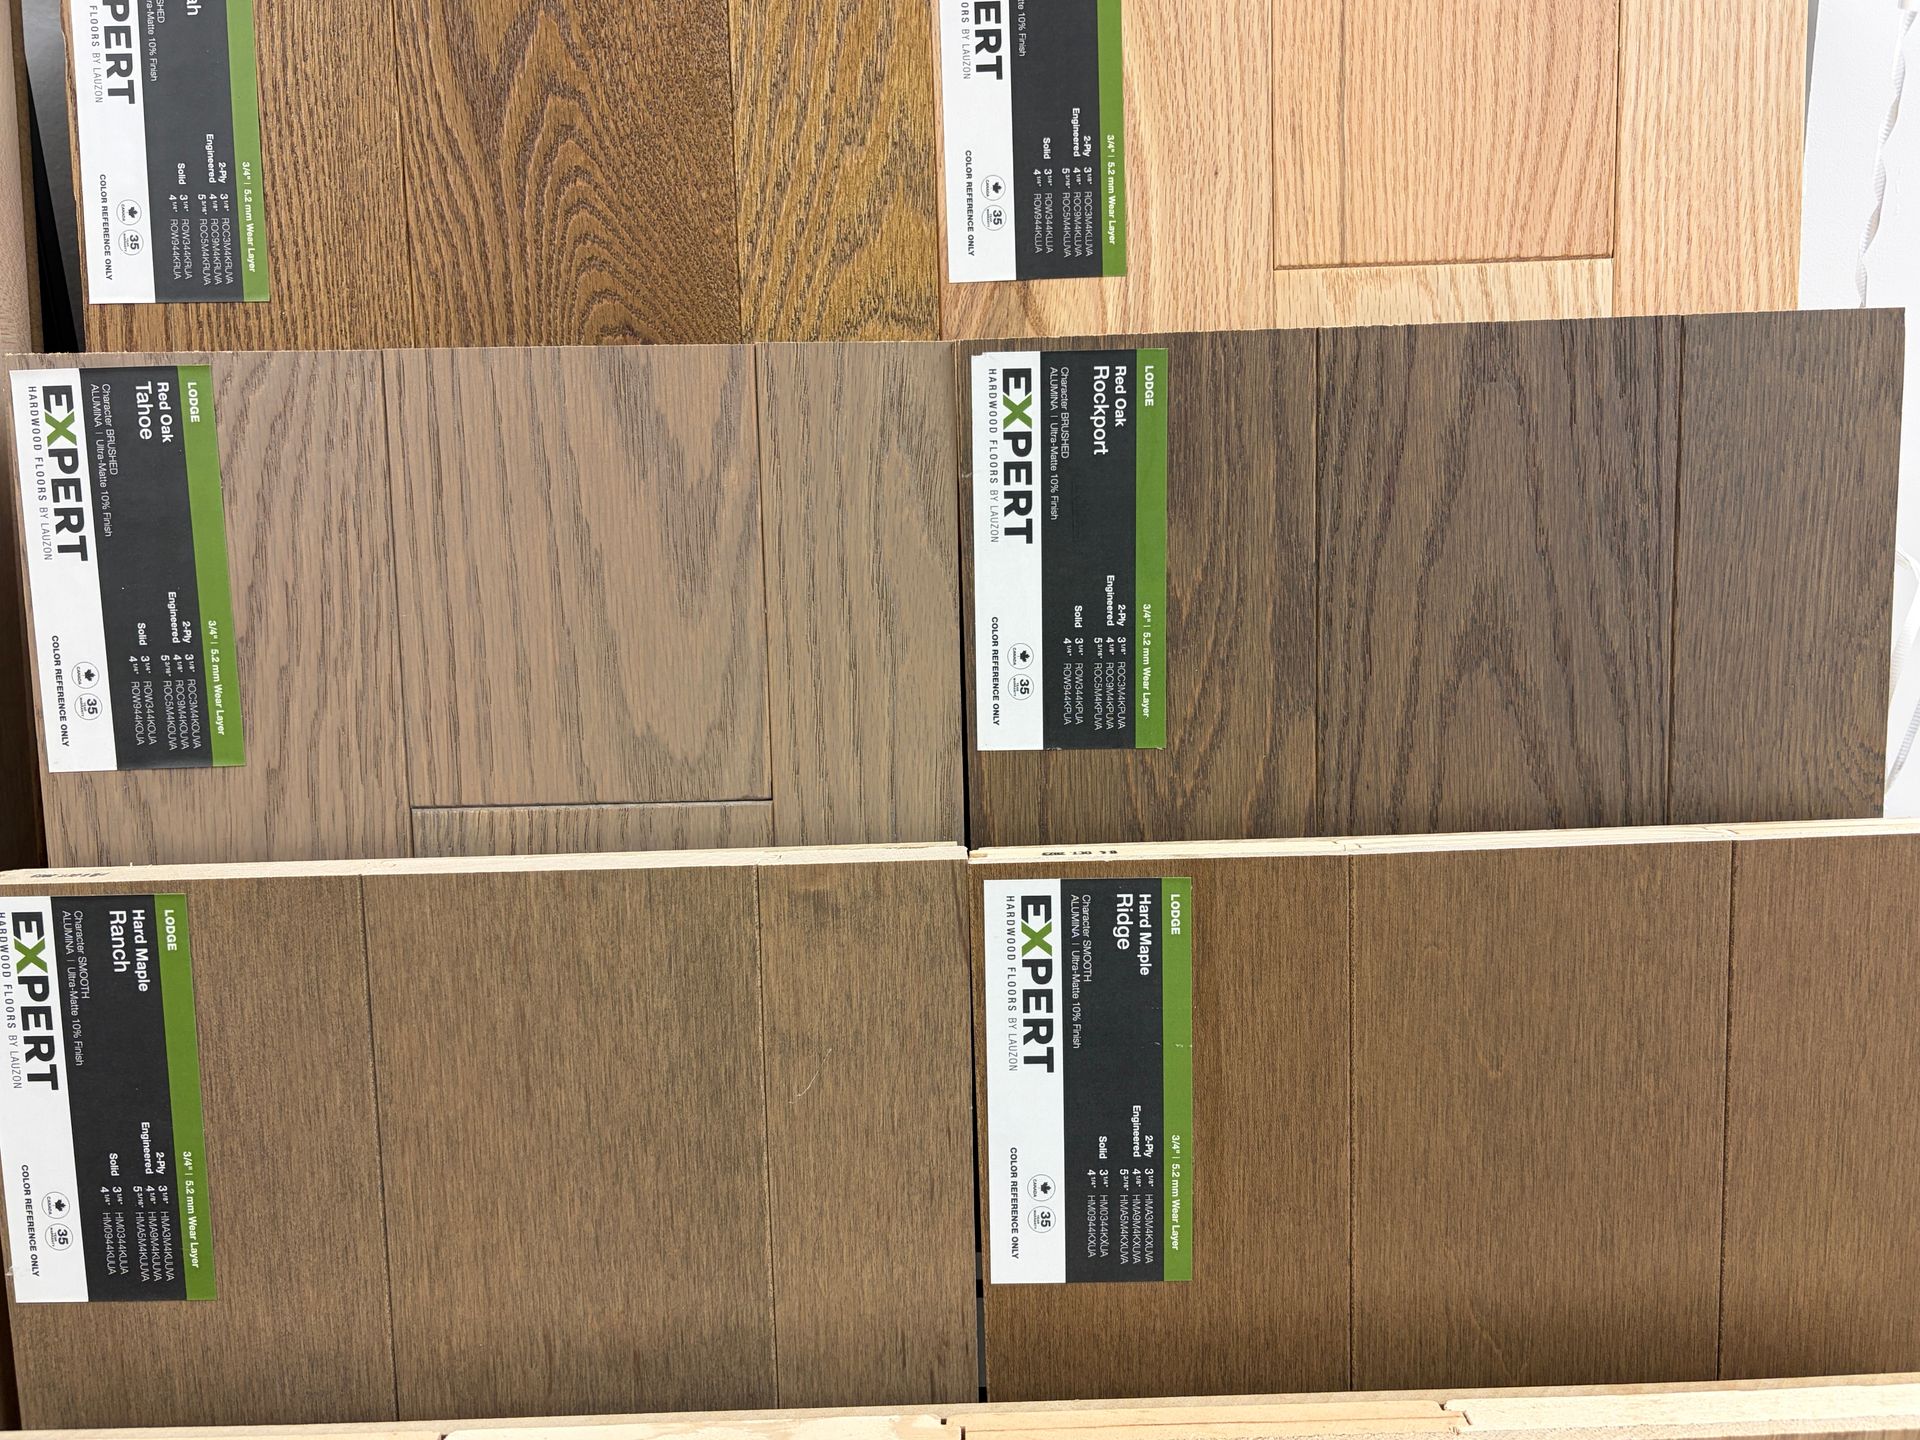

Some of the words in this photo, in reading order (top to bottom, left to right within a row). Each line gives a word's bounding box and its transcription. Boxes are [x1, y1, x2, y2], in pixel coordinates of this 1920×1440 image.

[89, 5, 100, 47] FLOORS
[961, 28, 970, 41] BY
[1017, 12, 1026, 31] 10%
[91, 52, 101, 64] BY
[148, 37, 157, 56] 10%
[1018, 32, 1027, 57] Finish
[149, 58, 158, 82] Finish
[961, 43, 972, 80] LAUZON
[92, 67, 104, 103] LAUZON
[1070, 107, 1081, 157] Engineered
[1106, 134, 1115, 153] 3/4"
[205, 133, 217, 183] Engineered
[1042, 137, 1051, 160] Solid
[1082, 135, 1092, 157] 2-Ply
[177, 162, 187, 185] Solid
[217, 162, 228, 184] 2-Ply
[241, 161, 251, 180] 3/4"
[965, 149, 973, 180] COLOR
[1107, 161, 1116, 176] 5.2
[99, 174, 108, 204] COLOR
[243, 188, 253, 203] 5.2
[1107, 176, 1115, 194] mm
[244, 204, 252, 222] mm
[966, 181, 975, 233] REFERENCE
[992, 209, 1003, 226] 35
[1108, 195, 1116, 219] Wear
[101, 205, 112, 257] REFERENCE
[129, 234, 140, 250] 35
[246, 223, 255, 247] Wear
[1107, 220, 1117, 245] Layer
[967, 234, 975, 257] ONLY
[104, 258, 113, 281] ONLY
[246, 247, 256, 273] Layer
[1049, 366, 1059, 411] ALUMINA
[1060, 366, 1070, 411] Character
[1115, 365, 1127, 394] Red
[1144, 365, 1155, 407] LODGE
[90, 383, 103, 428] ALUMINA
[101, 383, 113, 427] Character
[157, 382, 172, 410] Red
[187, 382, 200, 423] LODGE
[988, 368, 998, 434] HARDWOOD
[27, 386, 43, 451] HARDWOOD
[135, 380, 154, 440] Tahoe
[1089, 365, 1110, 456] Rockport
[1114, 397, 1127, 427] Oak
[160, 414, 174, 443] Oak
[1060, 412, 1070, 459] BRUSHED
[105, 429, 119, 475] BRUSHED
[1002, 367, 1033, 545] EXPERT
[1049, 422, 1059, 472] Ultra-Matte
[41, 384, 89, 562] EXPERT
[95, 439, 108, 488] Ultra-Matte
[989, 439, 999, 484] FLOORS
[34, 456, 48, 501] FLOORS
[1050, 474, 1059, 494] 10%
[100, 490, 111, 510] 10%
[989, 489, 999, 502] BY
[1050, 495, 1059, 521] Finish
[39, 506, 49, 519] BY
[102, 512, 113, 537] Finish
[989, 505, 1000, 543] LAUZON
[40, 522, 53, 561] LAUZON
[1104, 574, 1115, 626] Engineered
[1142, 603, 1152, 623] 3/4"
[167, 591, 181, 644] Engineered
[1074, 605, 1083, 628] Solid
[1116, 604, 1126, 627] 2-Ply
[137, 622, 148, 646] Solid
[182, 620, 192, 644] 2-Ply
[208, 620, 218, 639] 3/4"
[991, 616, 999, 647] COLOR
[1142, 632, 1151, 646] 5.2
[51, 635, 62, 666] COLOR
[210, 648, 220, 663] 5.2
[1142, 647, 1150, 665] mm
[212, 664, 220, 682] mm
[991, 649, 1000, 701] REFERENCE
[1019, 678, 1030, 695] 35
[1142, 666, 1152, 691] Wear
[54, 668, 67, 722] REFERENCE
[86, 698, 99, 715] 35
[213, 684, 223, 708] Wear
[1141, 692, 1151, 718] Layer
[215, 709, 225, 736] Layer
[992, 703, 1000, 726] ONLY
[60, 723, 70, 747] ONLY
[1070, 894, 1081, 939] ALUMINA
[1081, 894, 1092, 938] Character
[1113, 893, 1134, 950] Ridge
[1139, 894, 1152, 928] Hard
[1170, 893, 1181, 935] LODGE
[62, 910, 75, 955] ALUMINA
[73, 910, 85, 955] Character
[132, 909, 148, 944] Hard
[164, 909, 178, 951] LODGE
[1005, 895, 1017, 961] HARDWOOD
[109, 910, 131, 973] Ranch
[1138, 932, 1152, 976] Maple
[135, 948, 151, 992] Maple
[1082, 939, 1093, 982] SMOOTH
[77, 956, 91, 999] SMOOTH
[1020, 894, 1055, 1074] EXPERT
[1071, 950, 1081, 999] Ultra-Matte
[11, 911, 59, 1091] EXPERT
[67, 966, 79, 1016] Ultra-Matte
[1007, 966, 1017, 1012] FLOORS
[3, 984, 17, 1029] FLOORS
[1072, 1001, 1082, 1022] 10%
[72, 1018, 82, 1039] 10%
[1007, 1017, 1018, 1030] BY
[1072, 1023, 1082, 1049] Finish
[8, 1034, 19, 1047] BY
[73, 1040, 84, 1066] Finish
[1008, 1033, 1019, 1071] LAUZON
[9, 1050, 23, 1089] LAUZON
[1130, 1105, 1142, 1158] Engineered
[1171, 1134, 1181, 1154] 3/4"
[140, 1121, 154, 1175] Engineered
[1098, 1135, 1108, 1159] Solid
[1143, 1135, 1154, 1158] 2-Ply
[109, 1152, 120, 1177] Solid
[155, 1151, 166, 1175] 2-Ply
[182, 1151, 193, 1171] 3/4"
[1009, 1147, 1018, 1178] COLOR
[1171, 1163, 1181, 1178] 5.2
[21, 1164, 32, 1196] COLOR
[185, 1180, 195, 1195] 5.2
[1171, 1179, 1179, 1197] mm
[186, 1196, 195, 1214] mm
[1010, 1180, 1019, 1234] REFERENCE
[1171, 1199, 1181, 1223] Wear
[24, 1198, 38, 1252] REFERENCE
[188, 1215, 198, 1241] Wear
[1040, 1211, 1052, 1228] 35
[57, 1228, 69, 1245] 35
[1011, 1236, 1019, 1260] ONLY
[1170, 1224, 1181, 1251] Layer
[30, 1253, 40, 1277] ONLY
[189, 1242, 199, 1269] Layer
